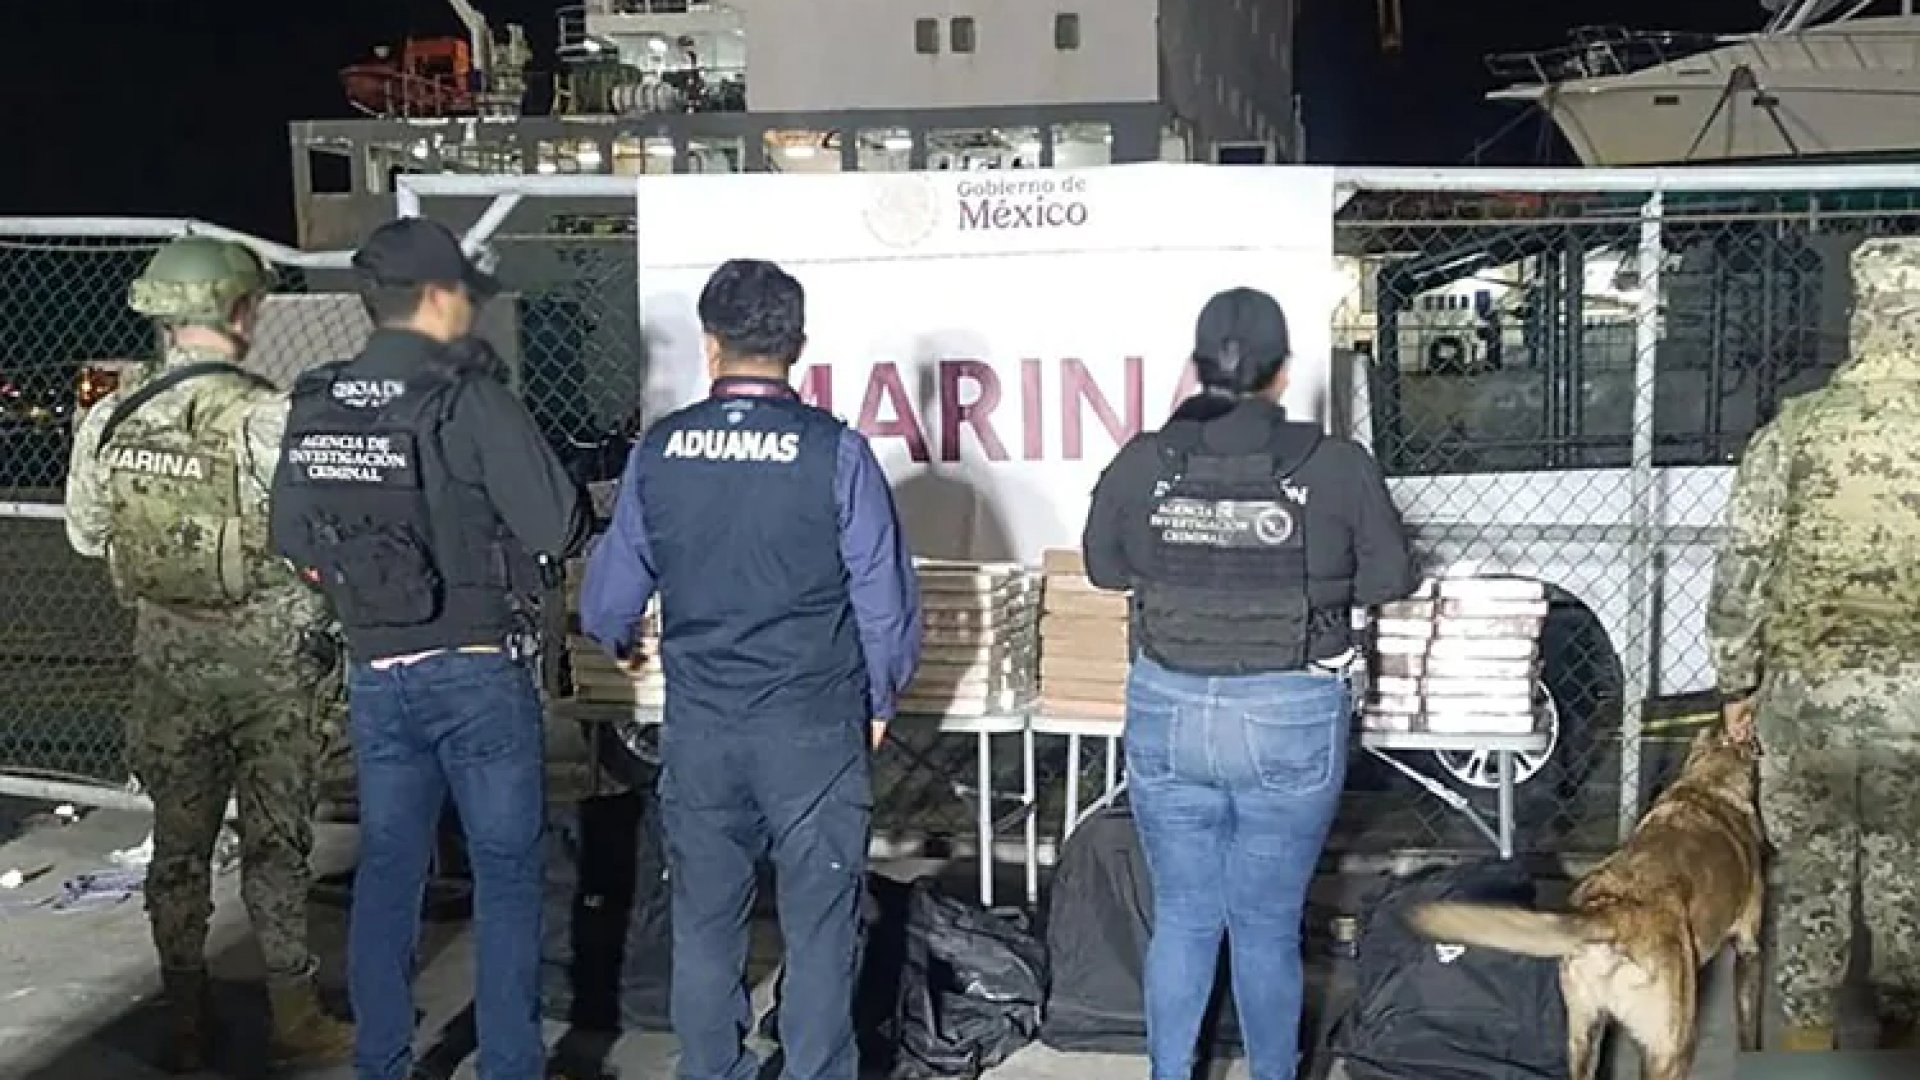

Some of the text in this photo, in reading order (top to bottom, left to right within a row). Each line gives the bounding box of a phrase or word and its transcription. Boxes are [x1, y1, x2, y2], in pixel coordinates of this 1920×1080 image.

[957, 175, 1087, 198] Gobierno de
[957, 195, 1089, 231] México
[800, 356, 1203, 463] ARIN
[301, 434, 390, 451] AGENCIA DE
[662, 429, 800, 463] ADUANAS
